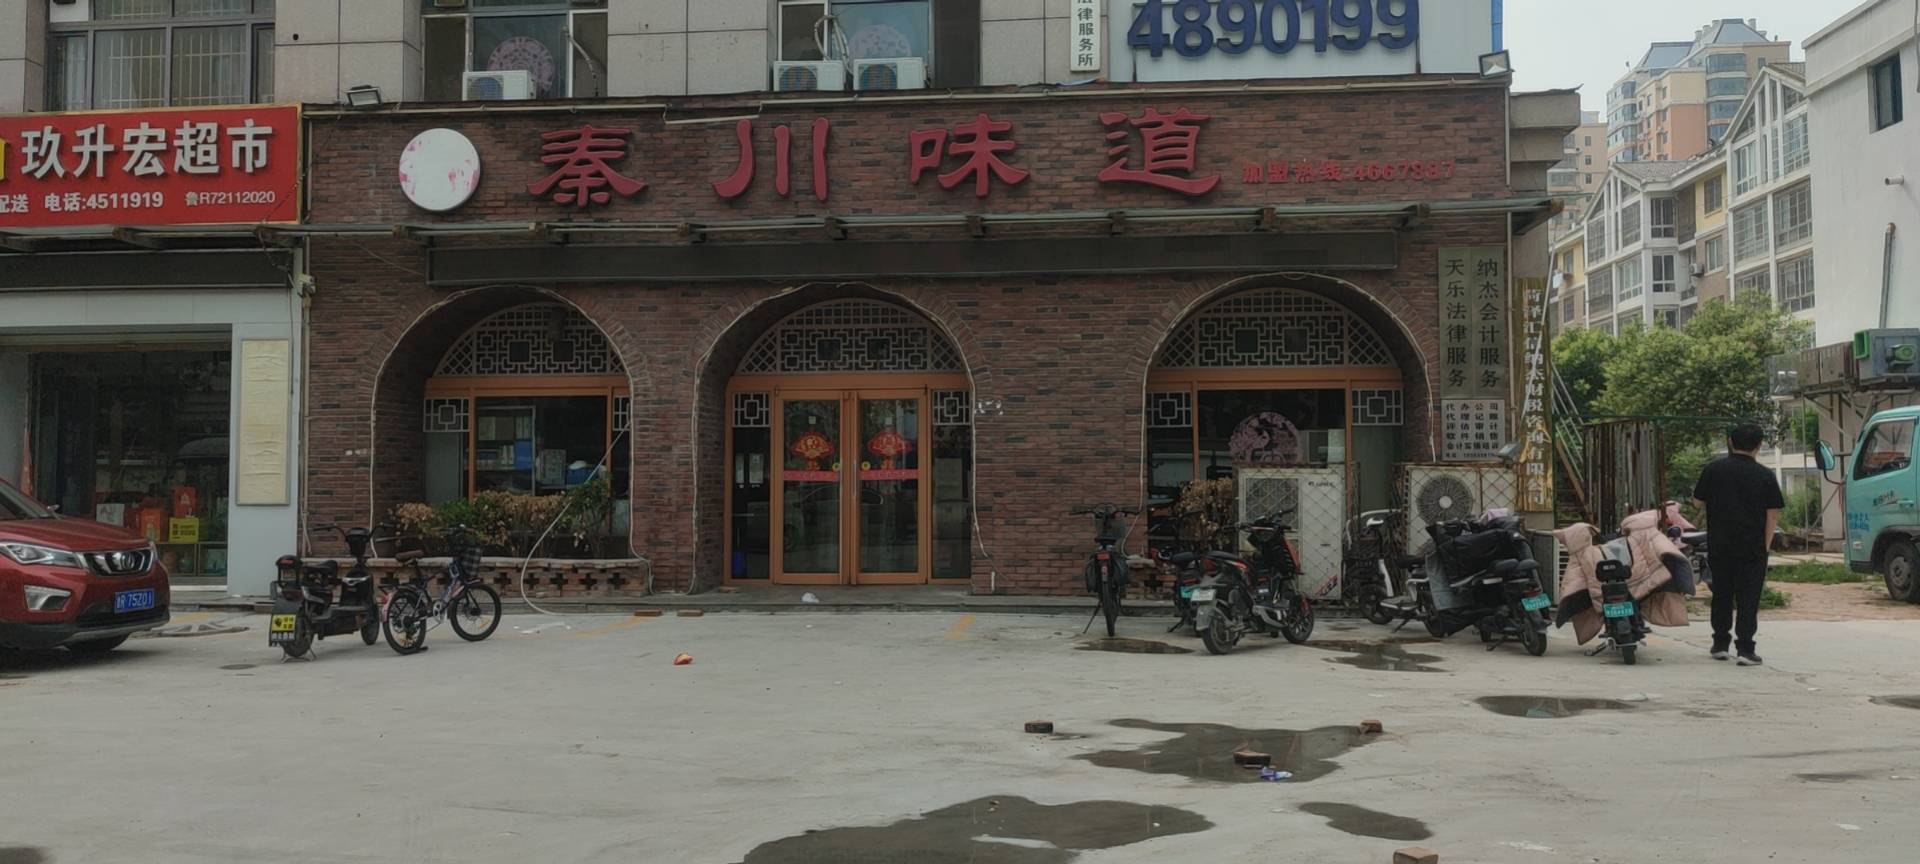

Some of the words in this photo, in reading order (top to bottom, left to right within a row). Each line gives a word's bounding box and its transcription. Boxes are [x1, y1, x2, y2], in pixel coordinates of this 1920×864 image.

[1077, 0, 1094, 66] 律服务所
[1127, 0, 1419, 57] 4890199
[20, 118, 272, 180] 玖升宏超市
[527, 107, 1221, 206] 秦川味道
[44, 192, 163, 212] 电话:4511919
[185, 191, 275, 206] 鲁R72112020
[1445, 258, 1467, 388] 天乐法律服务
[1477, 258, 1500, 389] 纳杰会计服务
